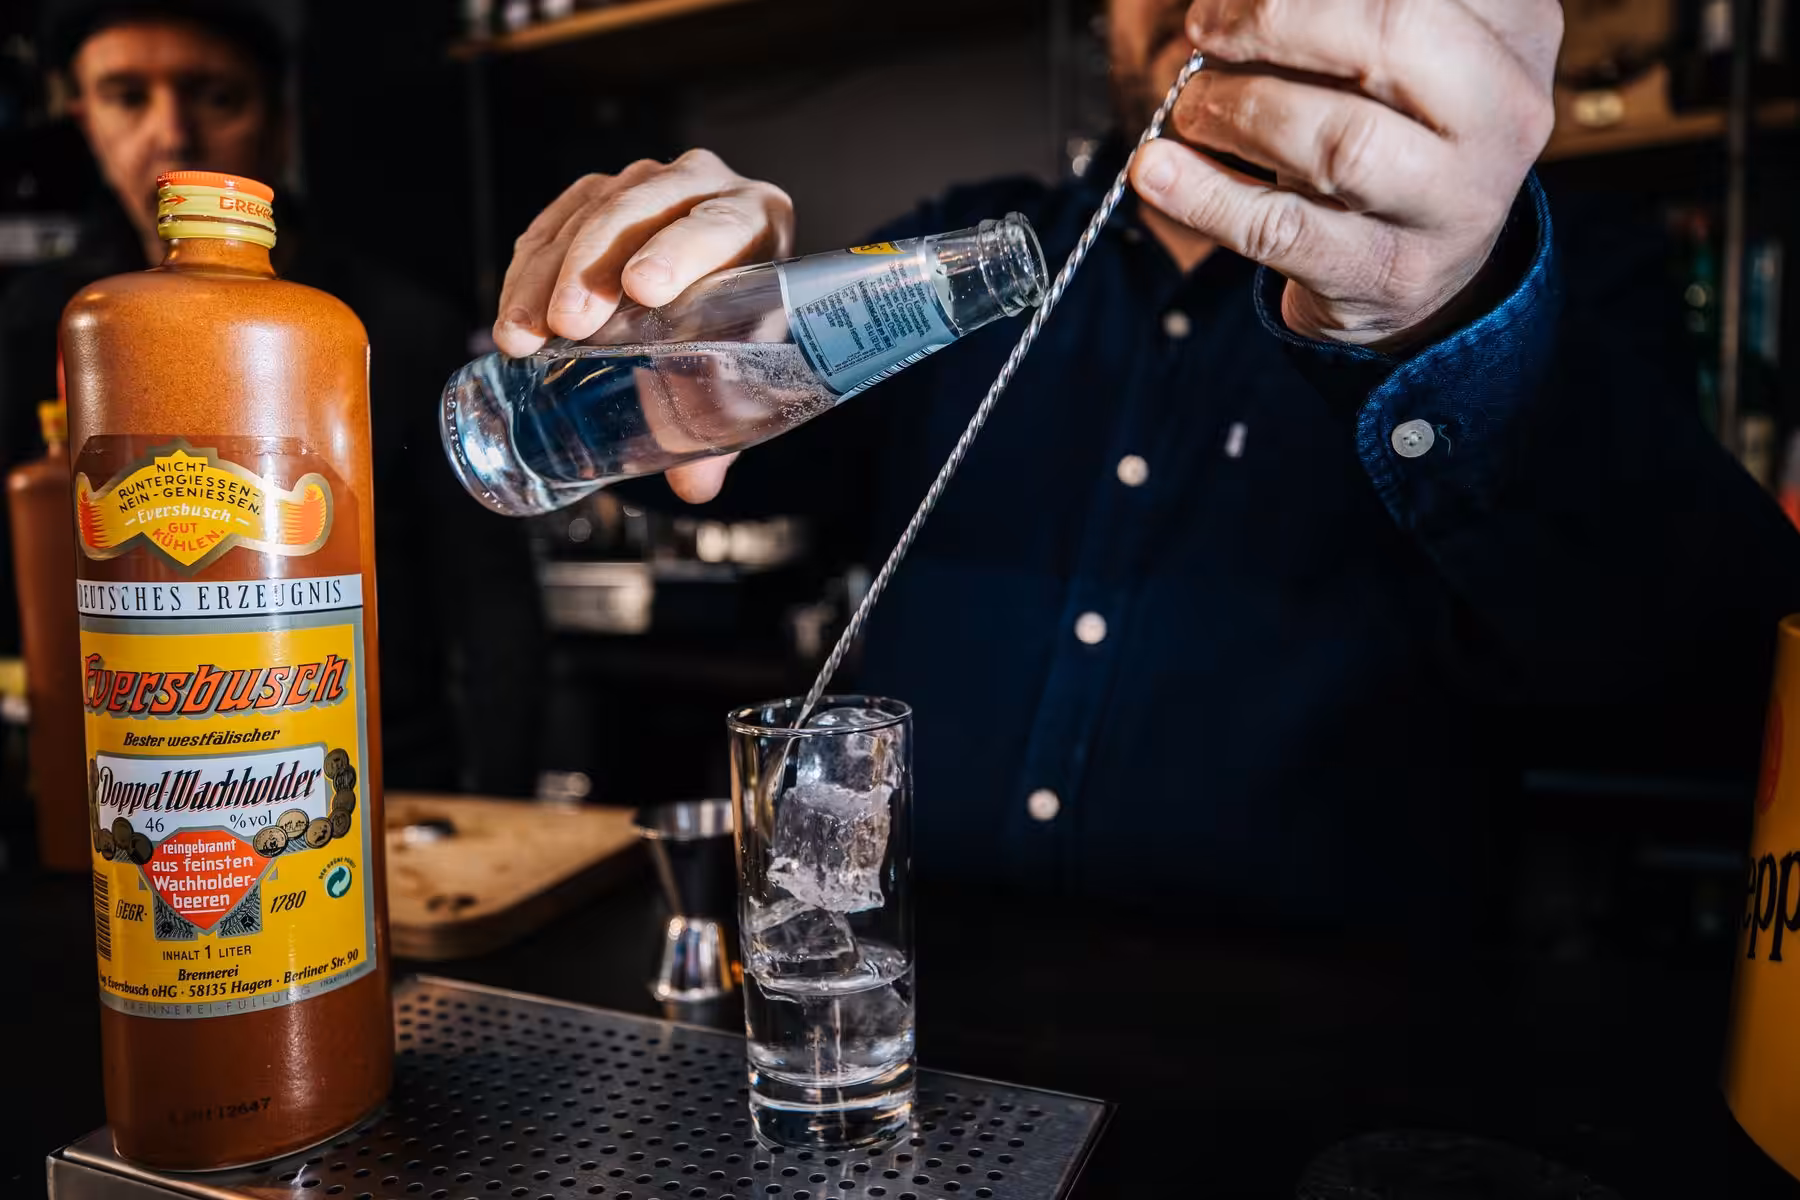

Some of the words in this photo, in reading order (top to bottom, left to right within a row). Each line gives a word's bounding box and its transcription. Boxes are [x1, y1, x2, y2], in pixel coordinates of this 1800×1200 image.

[156, 461, 207, 474] NICHT
[137, 503, 232, 524] Eversbusch
[168, 522, 198, 534] GUT
[152, 527, 225, 552] KÜHLEN.
[79, 584, 182, 612] DEUTSCHES
[197, 579, 342, 611] ERZEUGNIS
[84, 653, 348, 716] Eversbusch
[123, 732, 165, 747] Bester
[167, 728, 280, 747] westfälischer
[145, 817, 164, 833] 46
[163, 839, 236, 857] reingebrannt
[152, 859, 178, 873] aus
[183, 855, 253, 872] feinsten
[153, 874, 257, 892] Wachholder-
[172, 893, 230, 909] beeren
[270, 890, 307, 914] 1780
[162, 950, 199, 961] INHALT
[204, 945, 212, 959] 1
[219, 945, 252, 958] LITER
[108, 976, 149, 996] Eversbusch
[152, 985, 177, 998] oHG
[189, 981, 226, 998] 58135
[231, 978, 272, 996] Hagen
[284, 964, 329, 984] Berliner
[331, 956, 347, 971] Str.
[347, 948, 359, 962] 90
[178, 964, 239, 982] Brennerei
